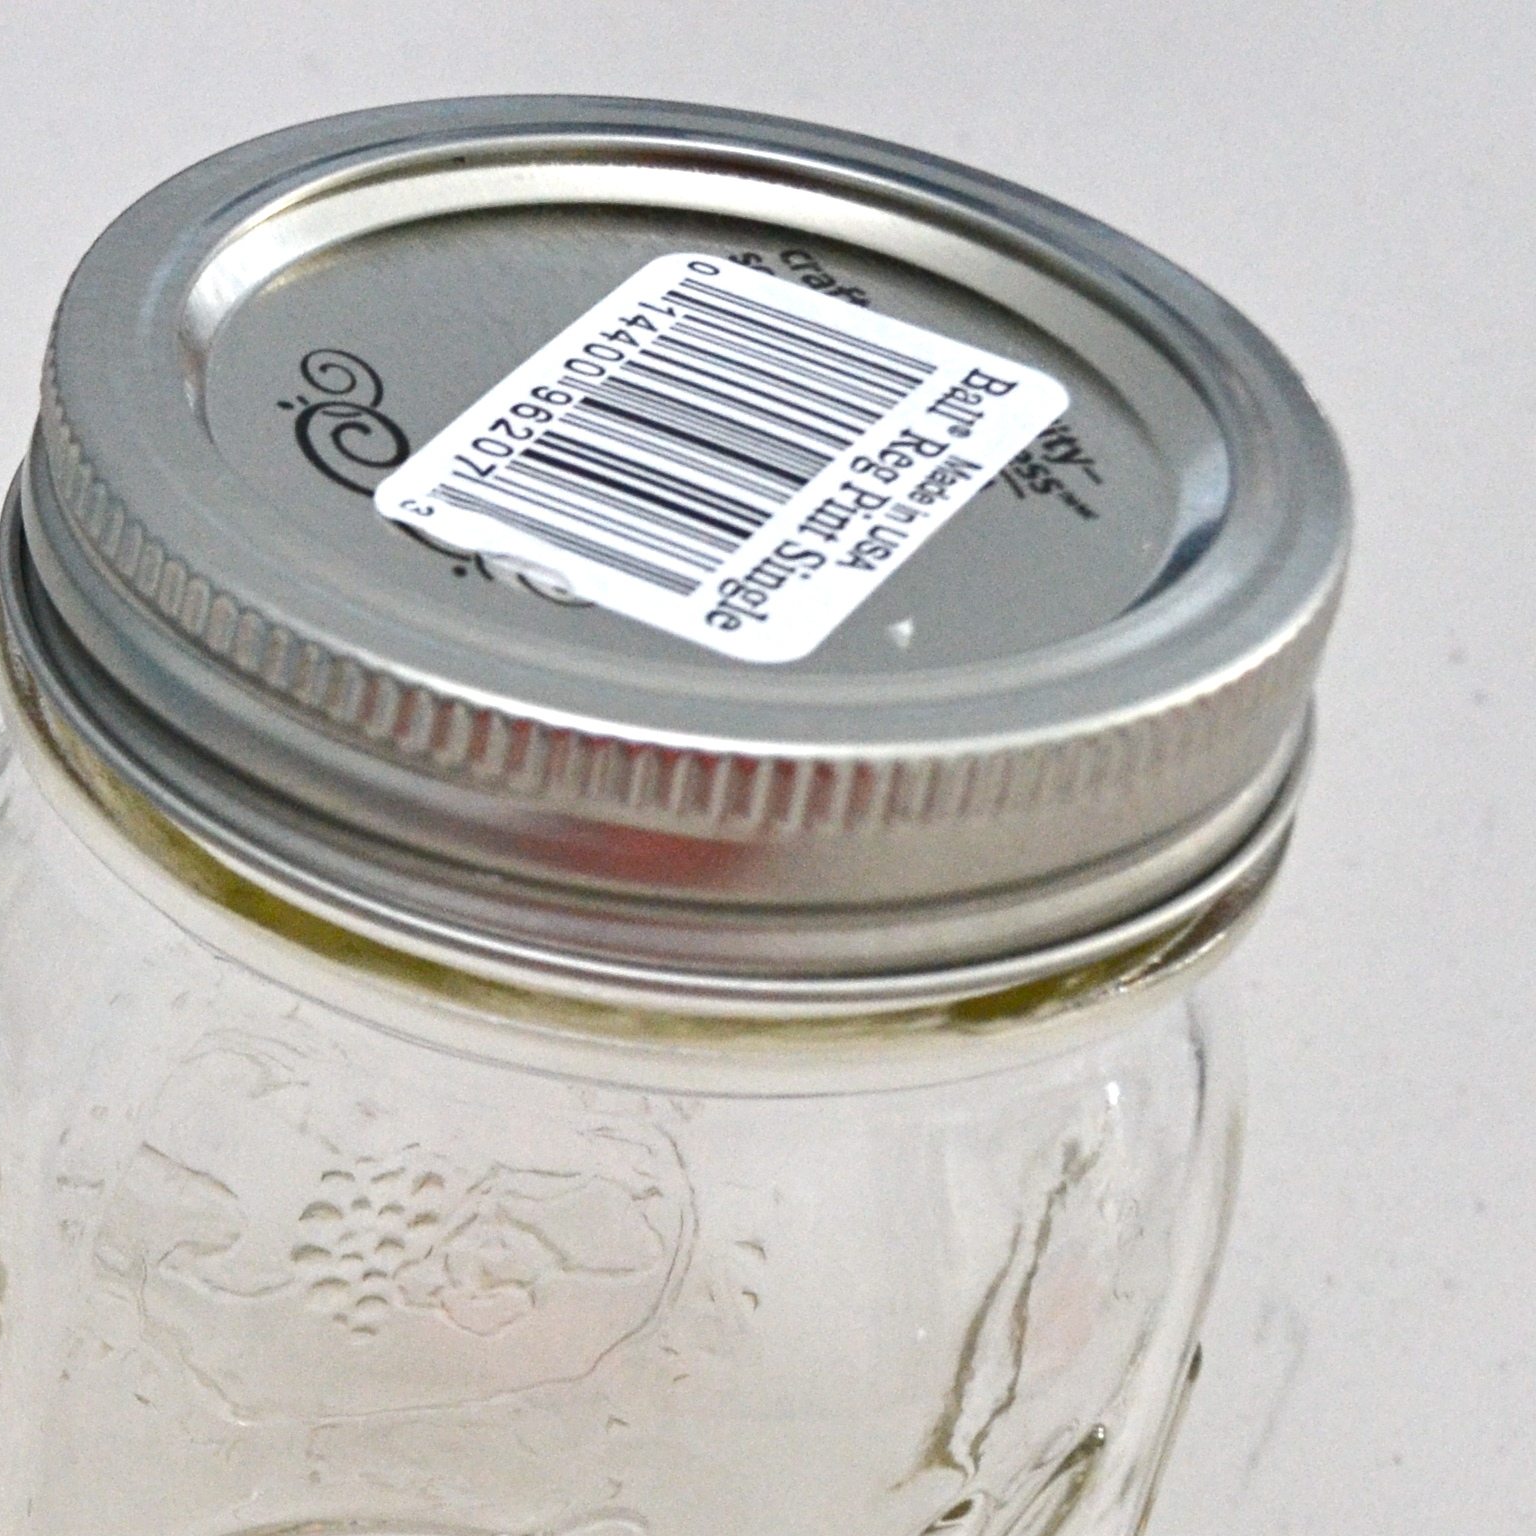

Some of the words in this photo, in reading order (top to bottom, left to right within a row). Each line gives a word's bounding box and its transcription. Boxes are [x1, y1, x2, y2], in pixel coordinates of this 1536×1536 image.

[686, 260, 721, 277] 0
[563, 301, 678, 378] 14400
[453, 385, 574, 478] 96207
[849, 428, 951, 485] Reg
[908, 454, 983, 506] Made
[399, 498, 435, 518] 3
[797, 480, 893, 542] Pint
[884, 502, 930, 524] in
[835, 524, 909, 571] USA
[705, 538, 827, 632] Single
